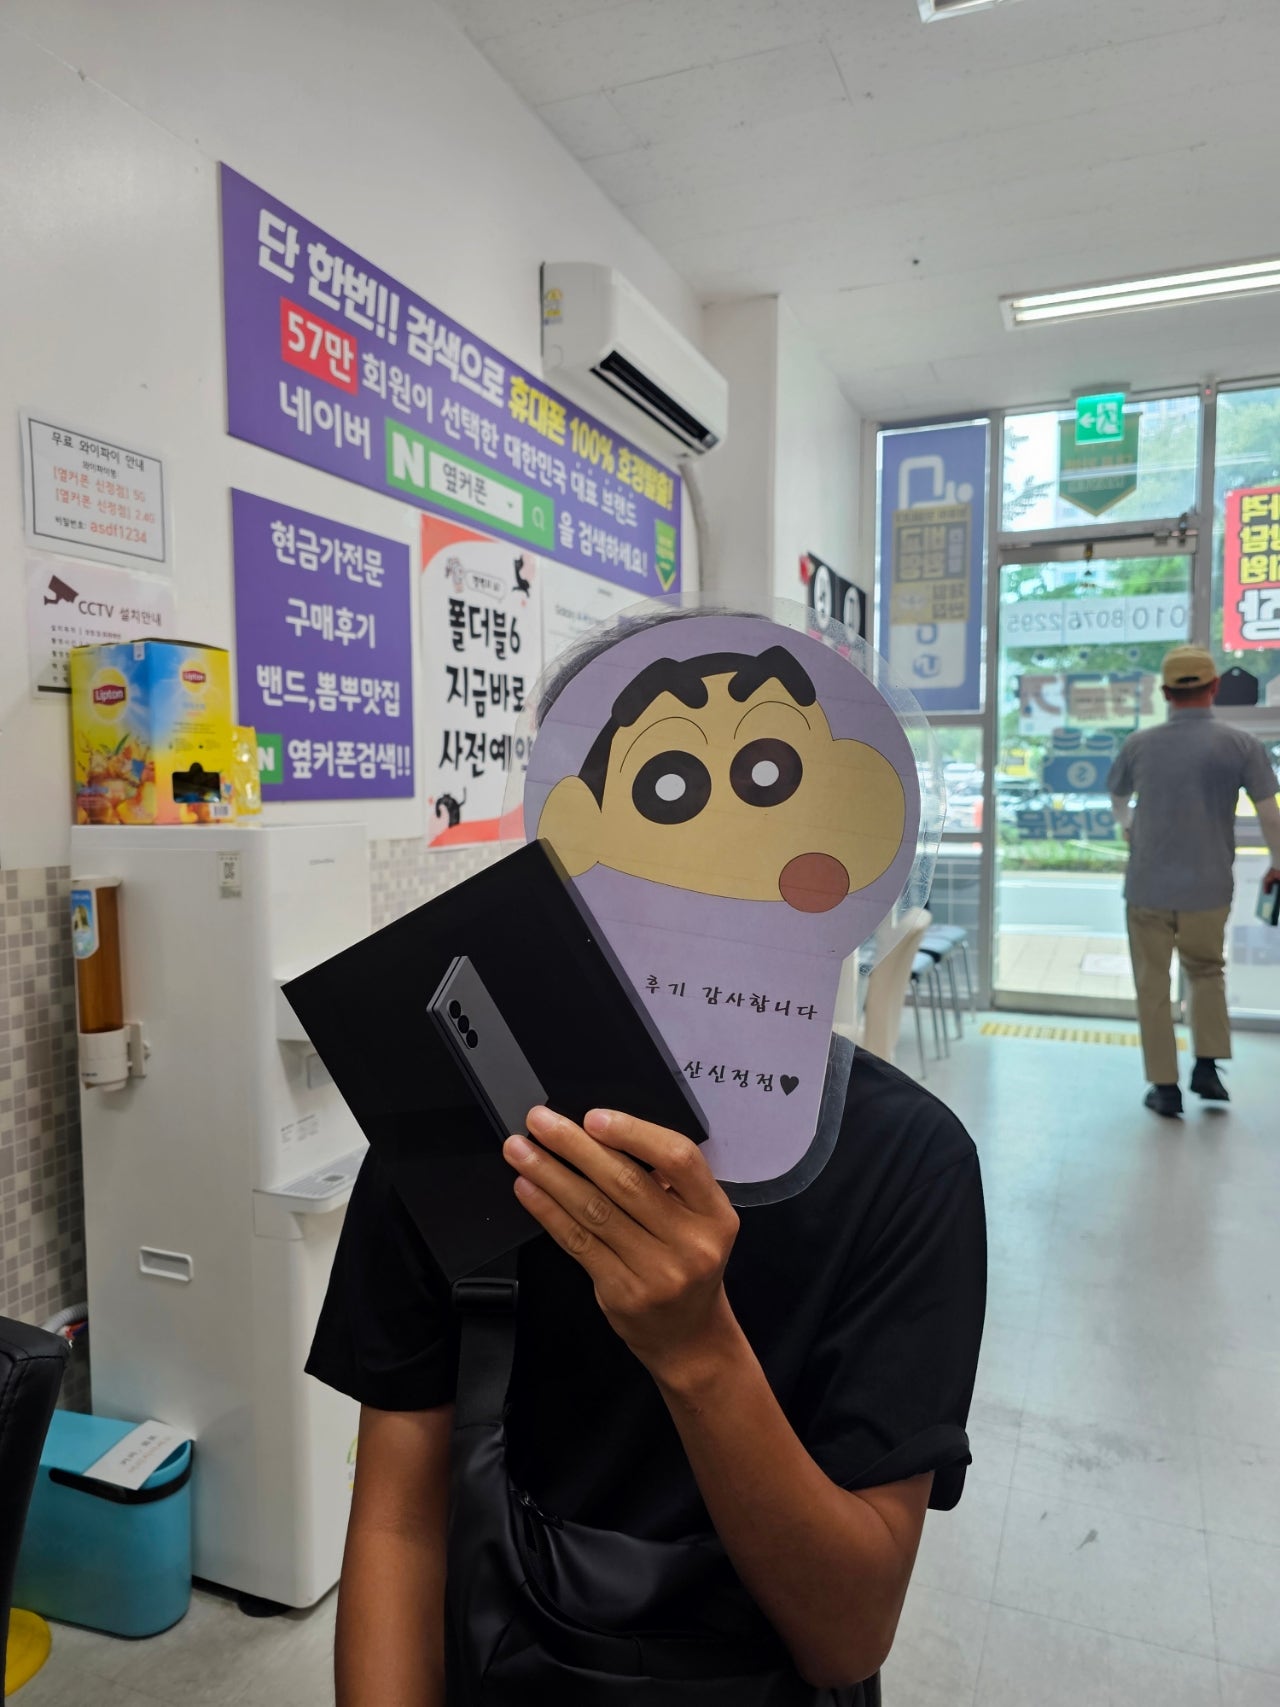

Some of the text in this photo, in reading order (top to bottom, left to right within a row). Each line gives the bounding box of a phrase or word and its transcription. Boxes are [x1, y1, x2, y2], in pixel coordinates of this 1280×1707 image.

[258, 208, 300, 284] 단
[307, 242, 400, 346] 한번!!
[406, 304, 505, 408] 검색으로
[508, 375, 567, 446] 휴대폰
[569, 417, 615, 474] 100%
[287, 310, 638, 528] 57만 회원이 선택한 대한민국 대표 브랜드
[51, 431, 146, 472] 무료 와이파이 안내
[279, 380, 371, 460] 네이버
[392, 431, 426, 489] N
[442, 462, 488, 506] 옆커폰
[557, 511, 576, 549] 을
[578, 520, 649, 578] 검색하세요!
[90, 520, 147, 543] asdf1234
[270, 520, 385, 588] 현금가전문
[78, 600, 163, 627] CCTV 설치안내
[285, 597, 376, 650] 구매후기
[447, 597, 521, 661] 폴더블6
[94, 688, 125, 704] Lipton
[256, 664, 400, 718] 밴드,뽐뿌맛집
[445, 665, 526, 718] 지금바로
[257, 738, 411, 780] N 옆커폰검색!!
[645, 974, 818, 1020] 후기 감사합니다
